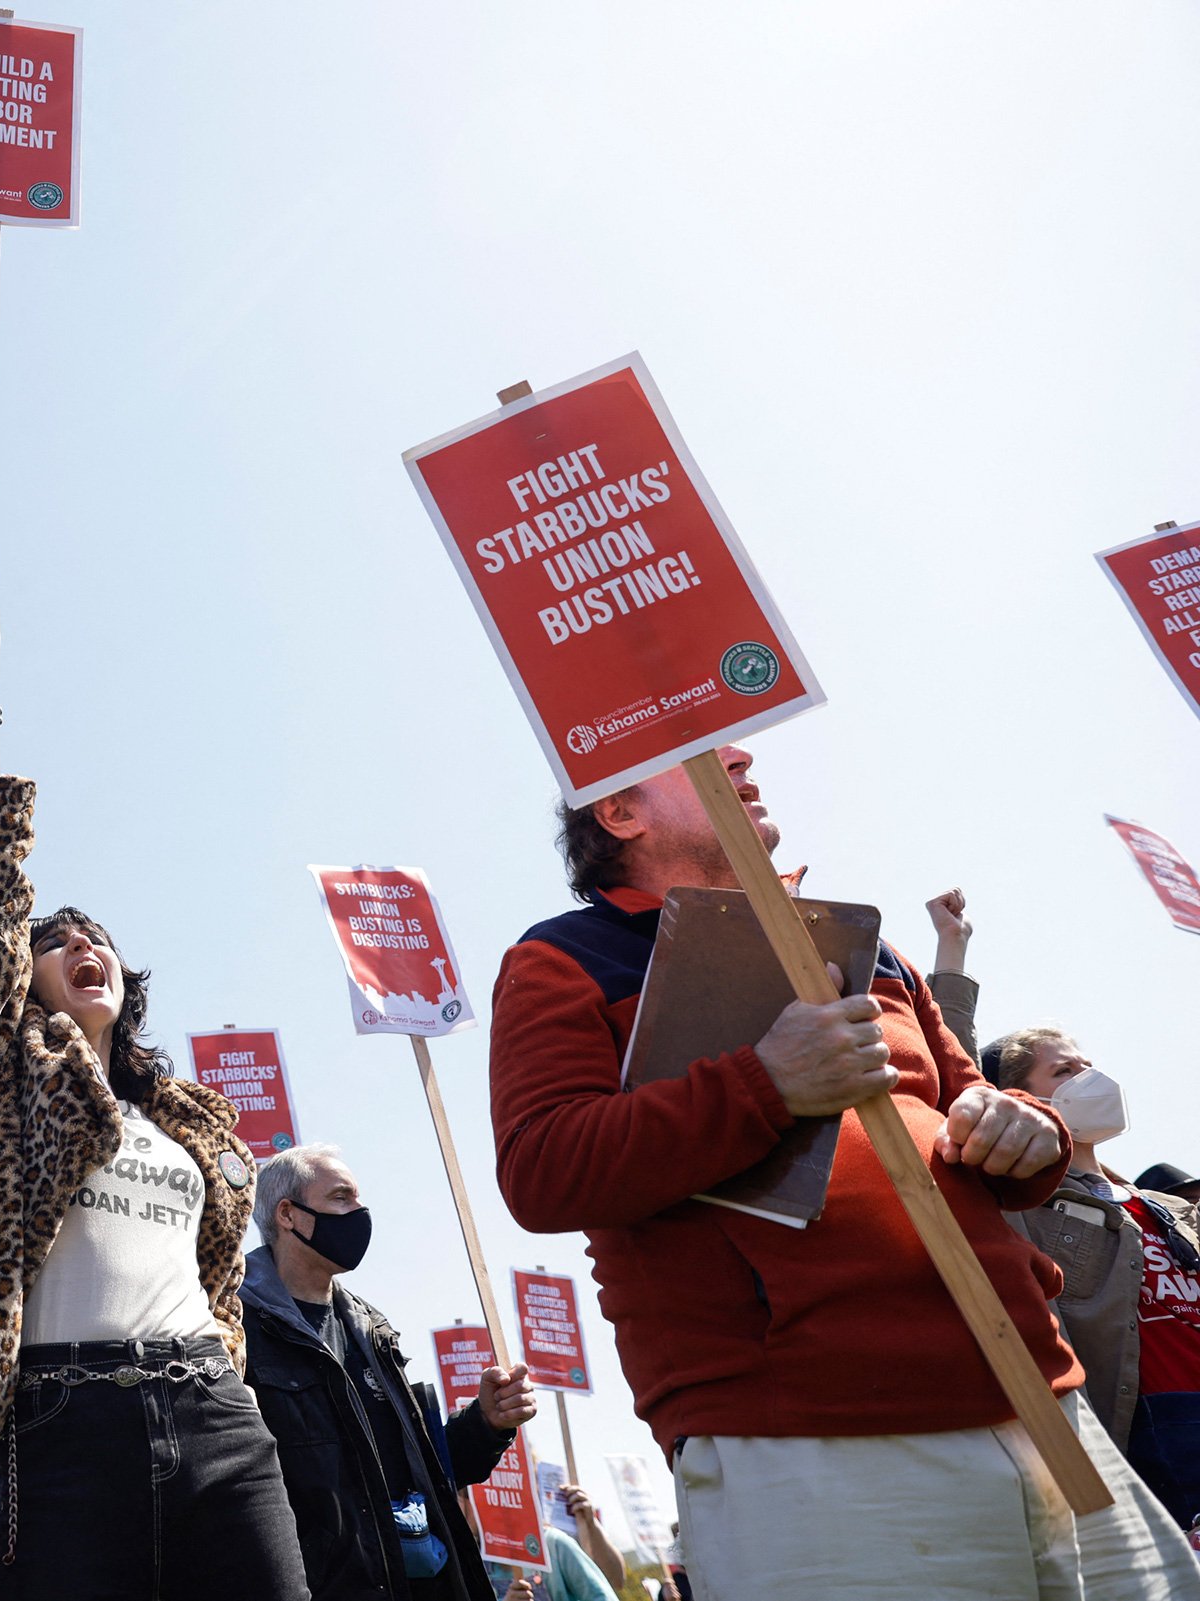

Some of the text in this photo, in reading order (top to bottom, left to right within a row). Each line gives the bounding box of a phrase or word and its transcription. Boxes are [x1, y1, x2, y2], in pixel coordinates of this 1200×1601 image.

[39, 62, 54, 81] A
[506, 444, 607, 513] FIGHT
[475, 461, 671, 574] STARBUCKS'
[542, 521, 655, 593] UNION
[1150, 546, 1200, 574] DEMA
[1148, 566, 1200, 595] STAR
[537, 550, 701, 646] BUSTING!
[1164, 586, 1200, 611] REI
[1163, 611, 1197, 635] ALL
[735, 682, 767, 692] WORKERS
[593, 695, 652, 726] Councilmember
[595, 705, 659, 738] Kshama
[659, 678, 717, 711] Sawant
[334, 882, 415, 899] STARBUCKS:
[359, 901, 400, 917] UNION
[349, 916, 422, 933] BUSTING IS
[351, 932, 429, 950] DISGUSTING
[219, 1051, 255, 1066] FIGHT
[201, 1065, 277, 1084] STARBUCKS'
[222, 1082, 264, 1097] UNION
[231, 1096, 276, 1112] STING!
[138, 1202, 191, 1231] JETT
[451, 1340, 477, 1352] FIGHT
[508, 1452, 519, 1470] IS
[492, 1471, 523, 1490] INJURY
[484, 1488, 523, 1509] TO ALL!
